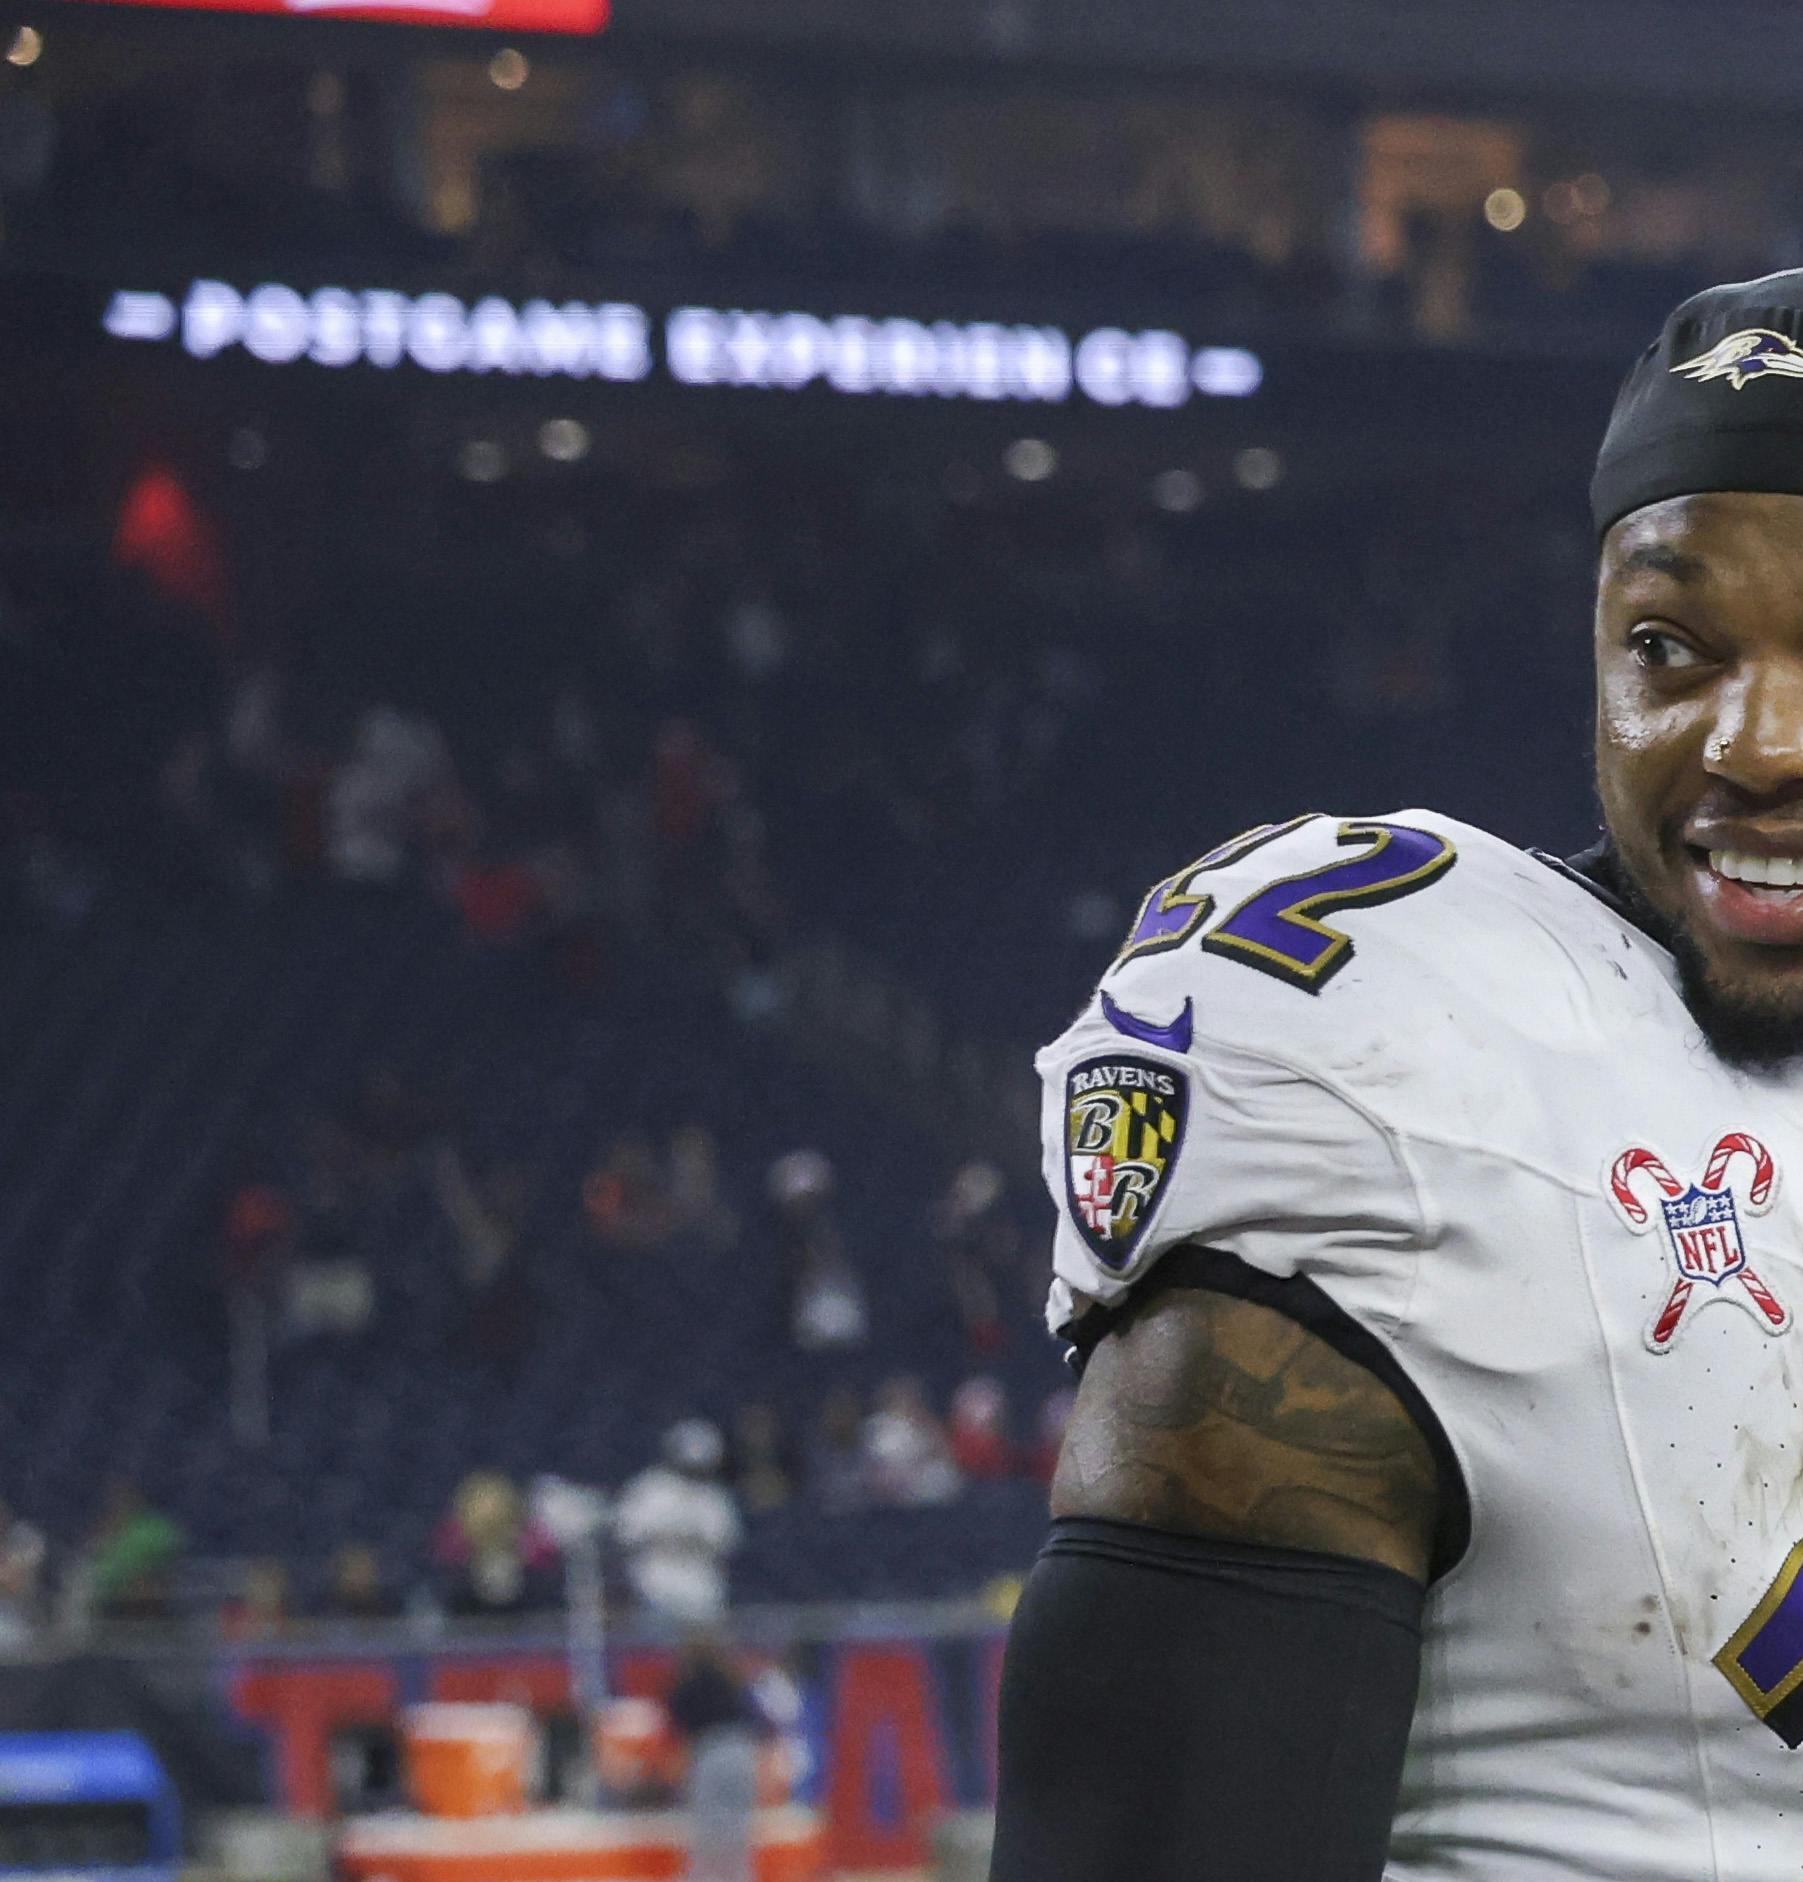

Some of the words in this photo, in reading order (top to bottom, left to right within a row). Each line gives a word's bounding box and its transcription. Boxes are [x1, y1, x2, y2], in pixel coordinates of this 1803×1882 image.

[183, 279, 650, 382] POSTGAME
[666, 306, 1191, 407] EXPERIENCE
[1072, 1066, 1175, 1096] RAVENS
[1677, 1225, 1739, 1274] NFL
